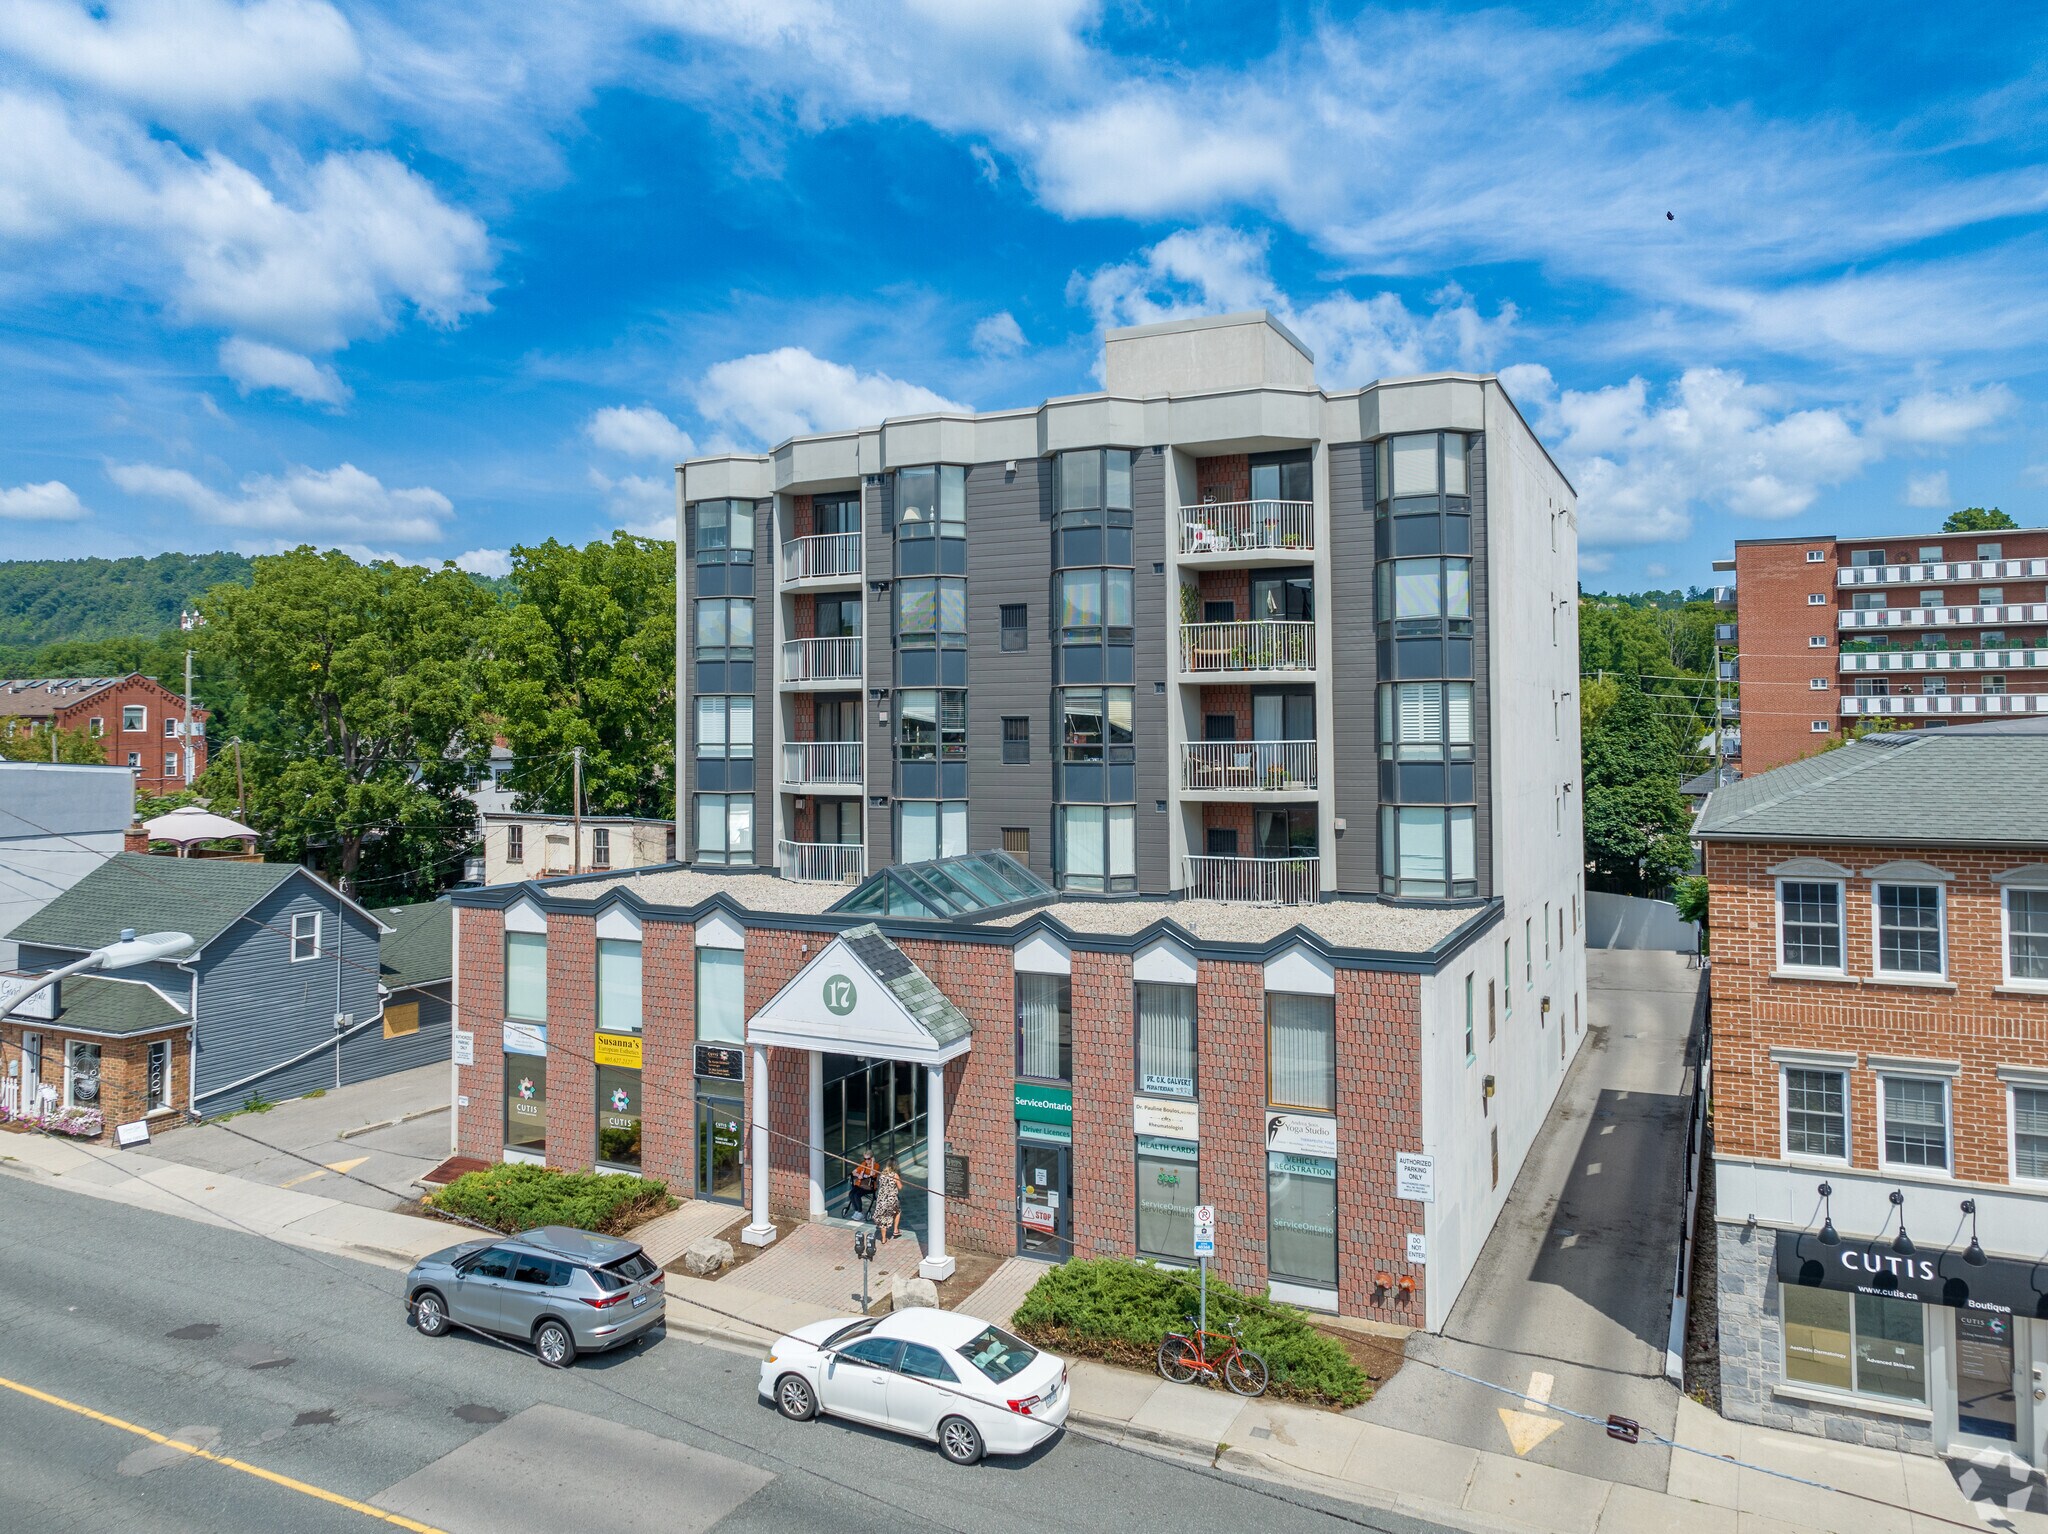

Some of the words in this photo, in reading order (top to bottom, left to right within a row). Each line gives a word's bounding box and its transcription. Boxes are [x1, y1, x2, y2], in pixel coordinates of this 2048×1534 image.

[828, 981, 850, 1008] 17
[598, 1036, 639, 1049] Susanna's
[1167, 1077, 1192, 1086] CALVERT
[516, 1103, 538, 1114] CUTIS
[1015, 1096, 1072, 1111] ServiceOntario
[609, 1117, 632, 1127] CUTIS
[1148, 1122, 1184, 1131] Rheumatologist
[1022, 1125, 1042, 1134] Driver
[1043, 1128, 1070, 1138] Licences
[1285, 1123, 1304, 1134] Yoga
[1305, 1126, 1330, 1135] Studio
[1140, 1141, 1169, 1151] HEALTH
[1170, 1145, 1196, 1155] CARDS
[1286, 1155, 1319, 1166] VEHICLE
[1399, 1157, 1432, 1167] AUTHORIZED
[1274, 1162, 1332, 1176] REGISTRATION
[1404, 1165, 1427, 1173] PARKING
[1035, 1211, 1052, 1221] STOP
[1273, 1218, 1334, 1234] ServiceOntario
[1408, 1251, 1426, 1259] ENTER
[1841, 1250, 1935, 1281] CUTIS
[1858, 1285, 1919, 1300] www.cutis.ca
[1968, 1299, 2011, 1313] Boutique
[1960, 1317, 1985, 1326] CUTIS
[1789, 1344, 1813, 1354] Aesthetic
[1813, 1348, 1847, 1359] Dermatology
[1866, 1357, 1893, 1366] Advanced
[1892, 1361, 1916, 1370] Skincare
